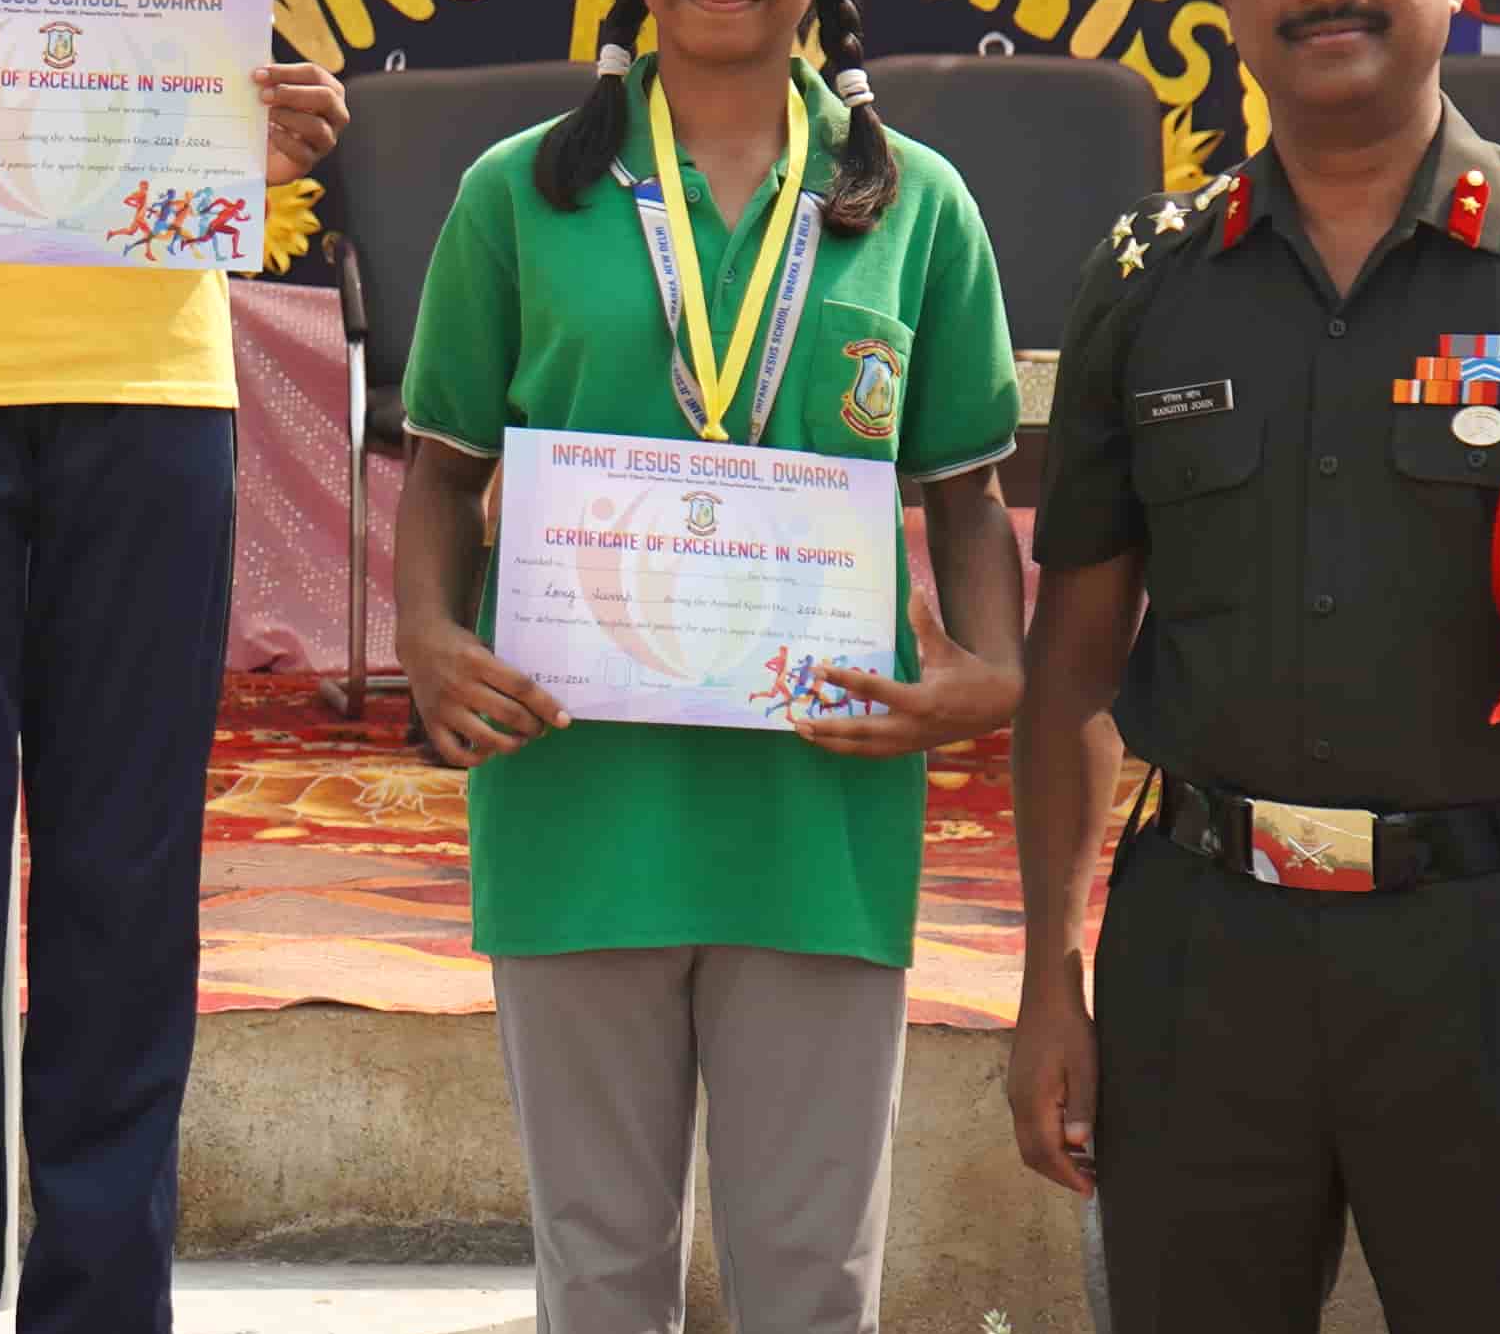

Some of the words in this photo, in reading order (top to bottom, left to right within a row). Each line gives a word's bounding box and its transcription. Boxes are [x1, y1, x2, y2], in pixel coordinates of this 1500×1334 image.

[1, 70, 20, 88] OF
[28, 71, 129, 92] EXCELLENCE
[137, 74, 154, 92] IN
[161, 75, 224, 95] SPORTS
[552, 443, 617, 469] INFANT
[624, 449, 682, 476] JESUS
[773, 461, 850, 491] DWARKA
[545, 528, 638, 551] CERTIFICATE
[647, 535, 665, 553] OF
[673, 538, 768, 562] EXCELLENCE
[775, 546, 790, 563] IN
[797, 547, 855, 569] SPORTS
